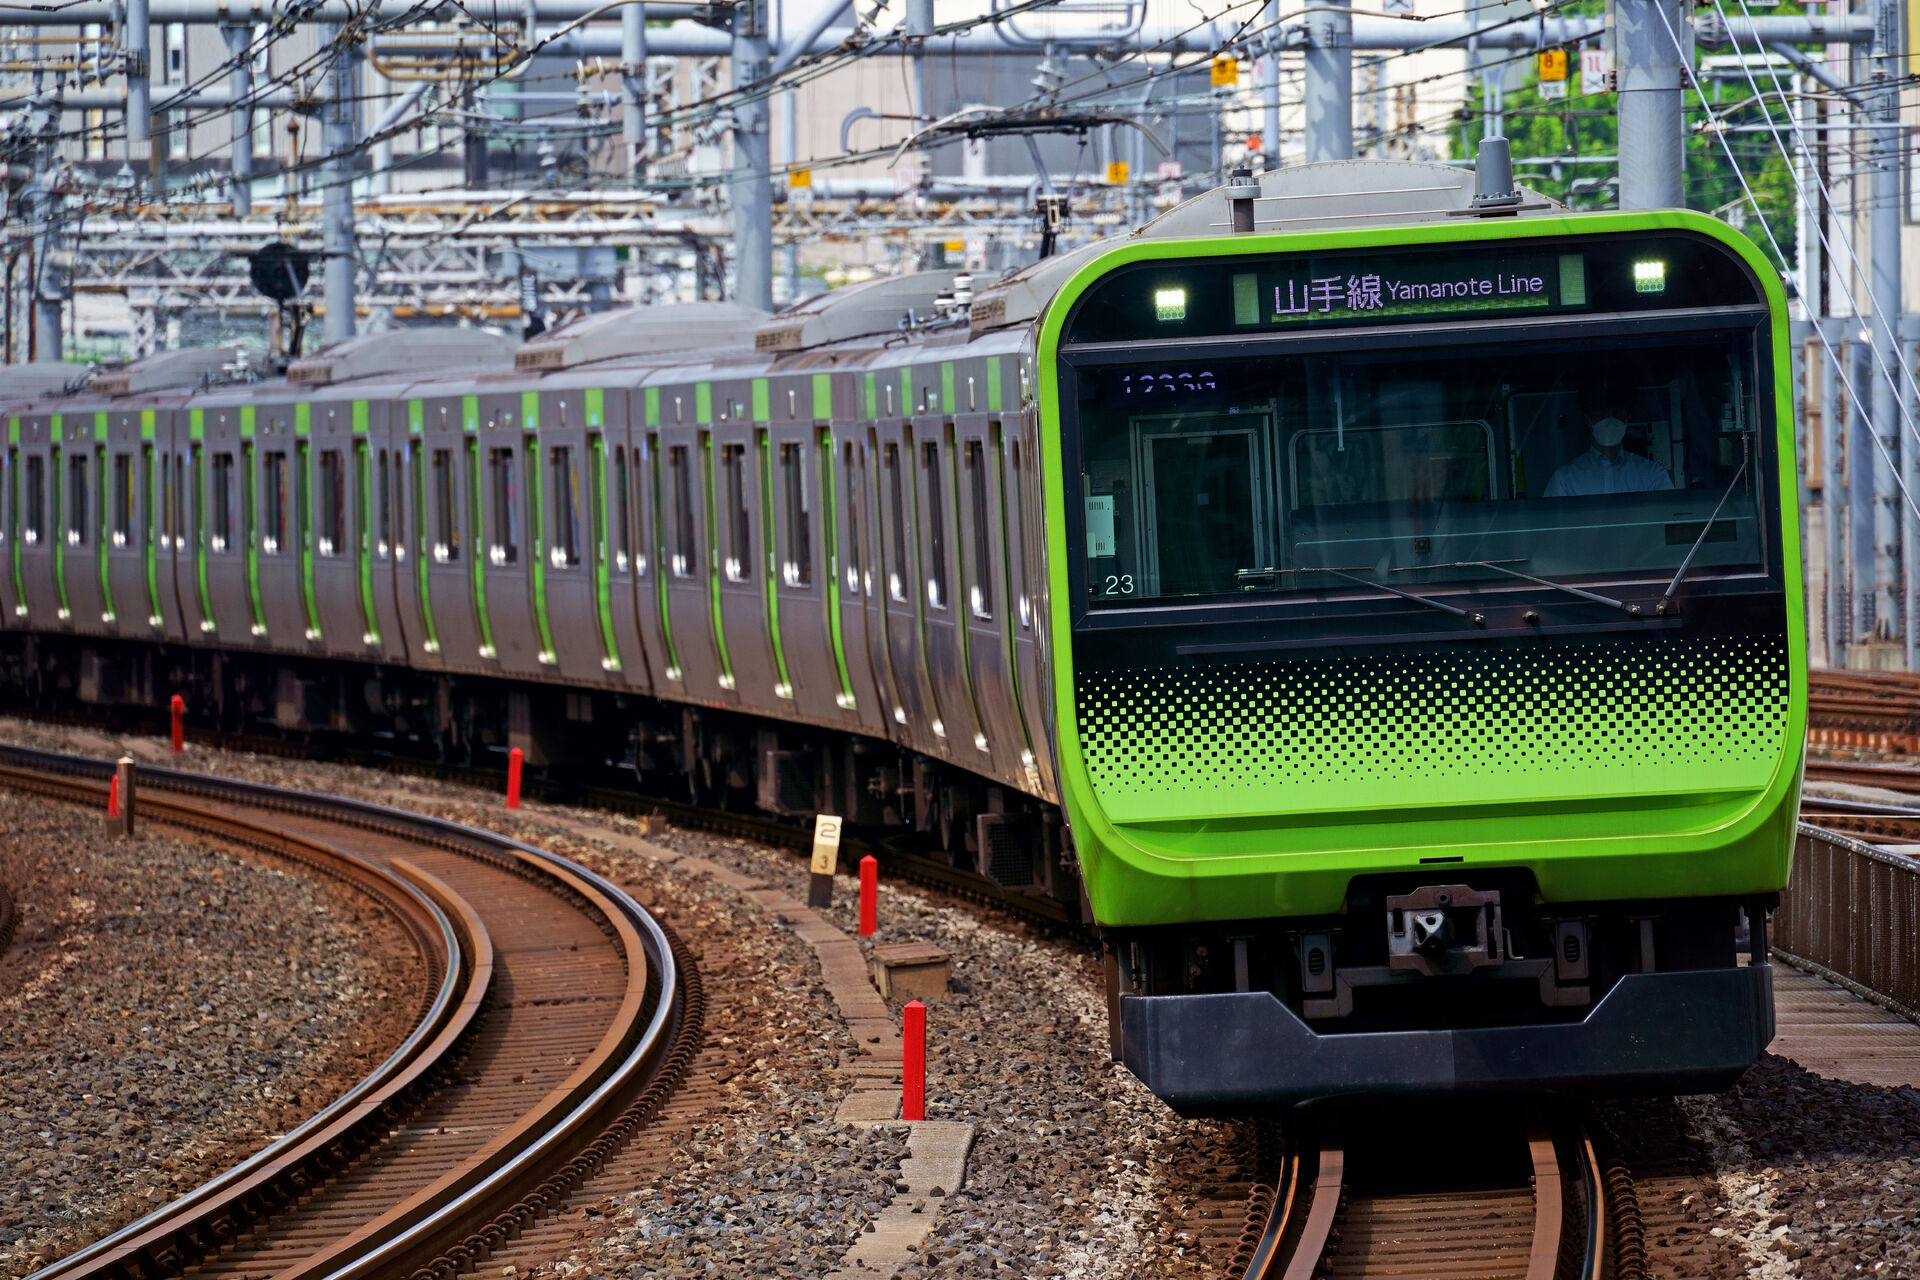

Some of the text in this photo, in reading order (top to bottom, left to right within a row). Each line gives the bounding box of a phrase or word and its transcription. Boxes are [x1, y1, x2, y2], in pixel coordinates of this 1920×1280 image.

[1274, 273, 1384, 314] 山手線
[1386, 273, 1544, 301] Yamanote Line
[1105, 574, 1134, 595] 23
[820, 822, 837, 839] 2
